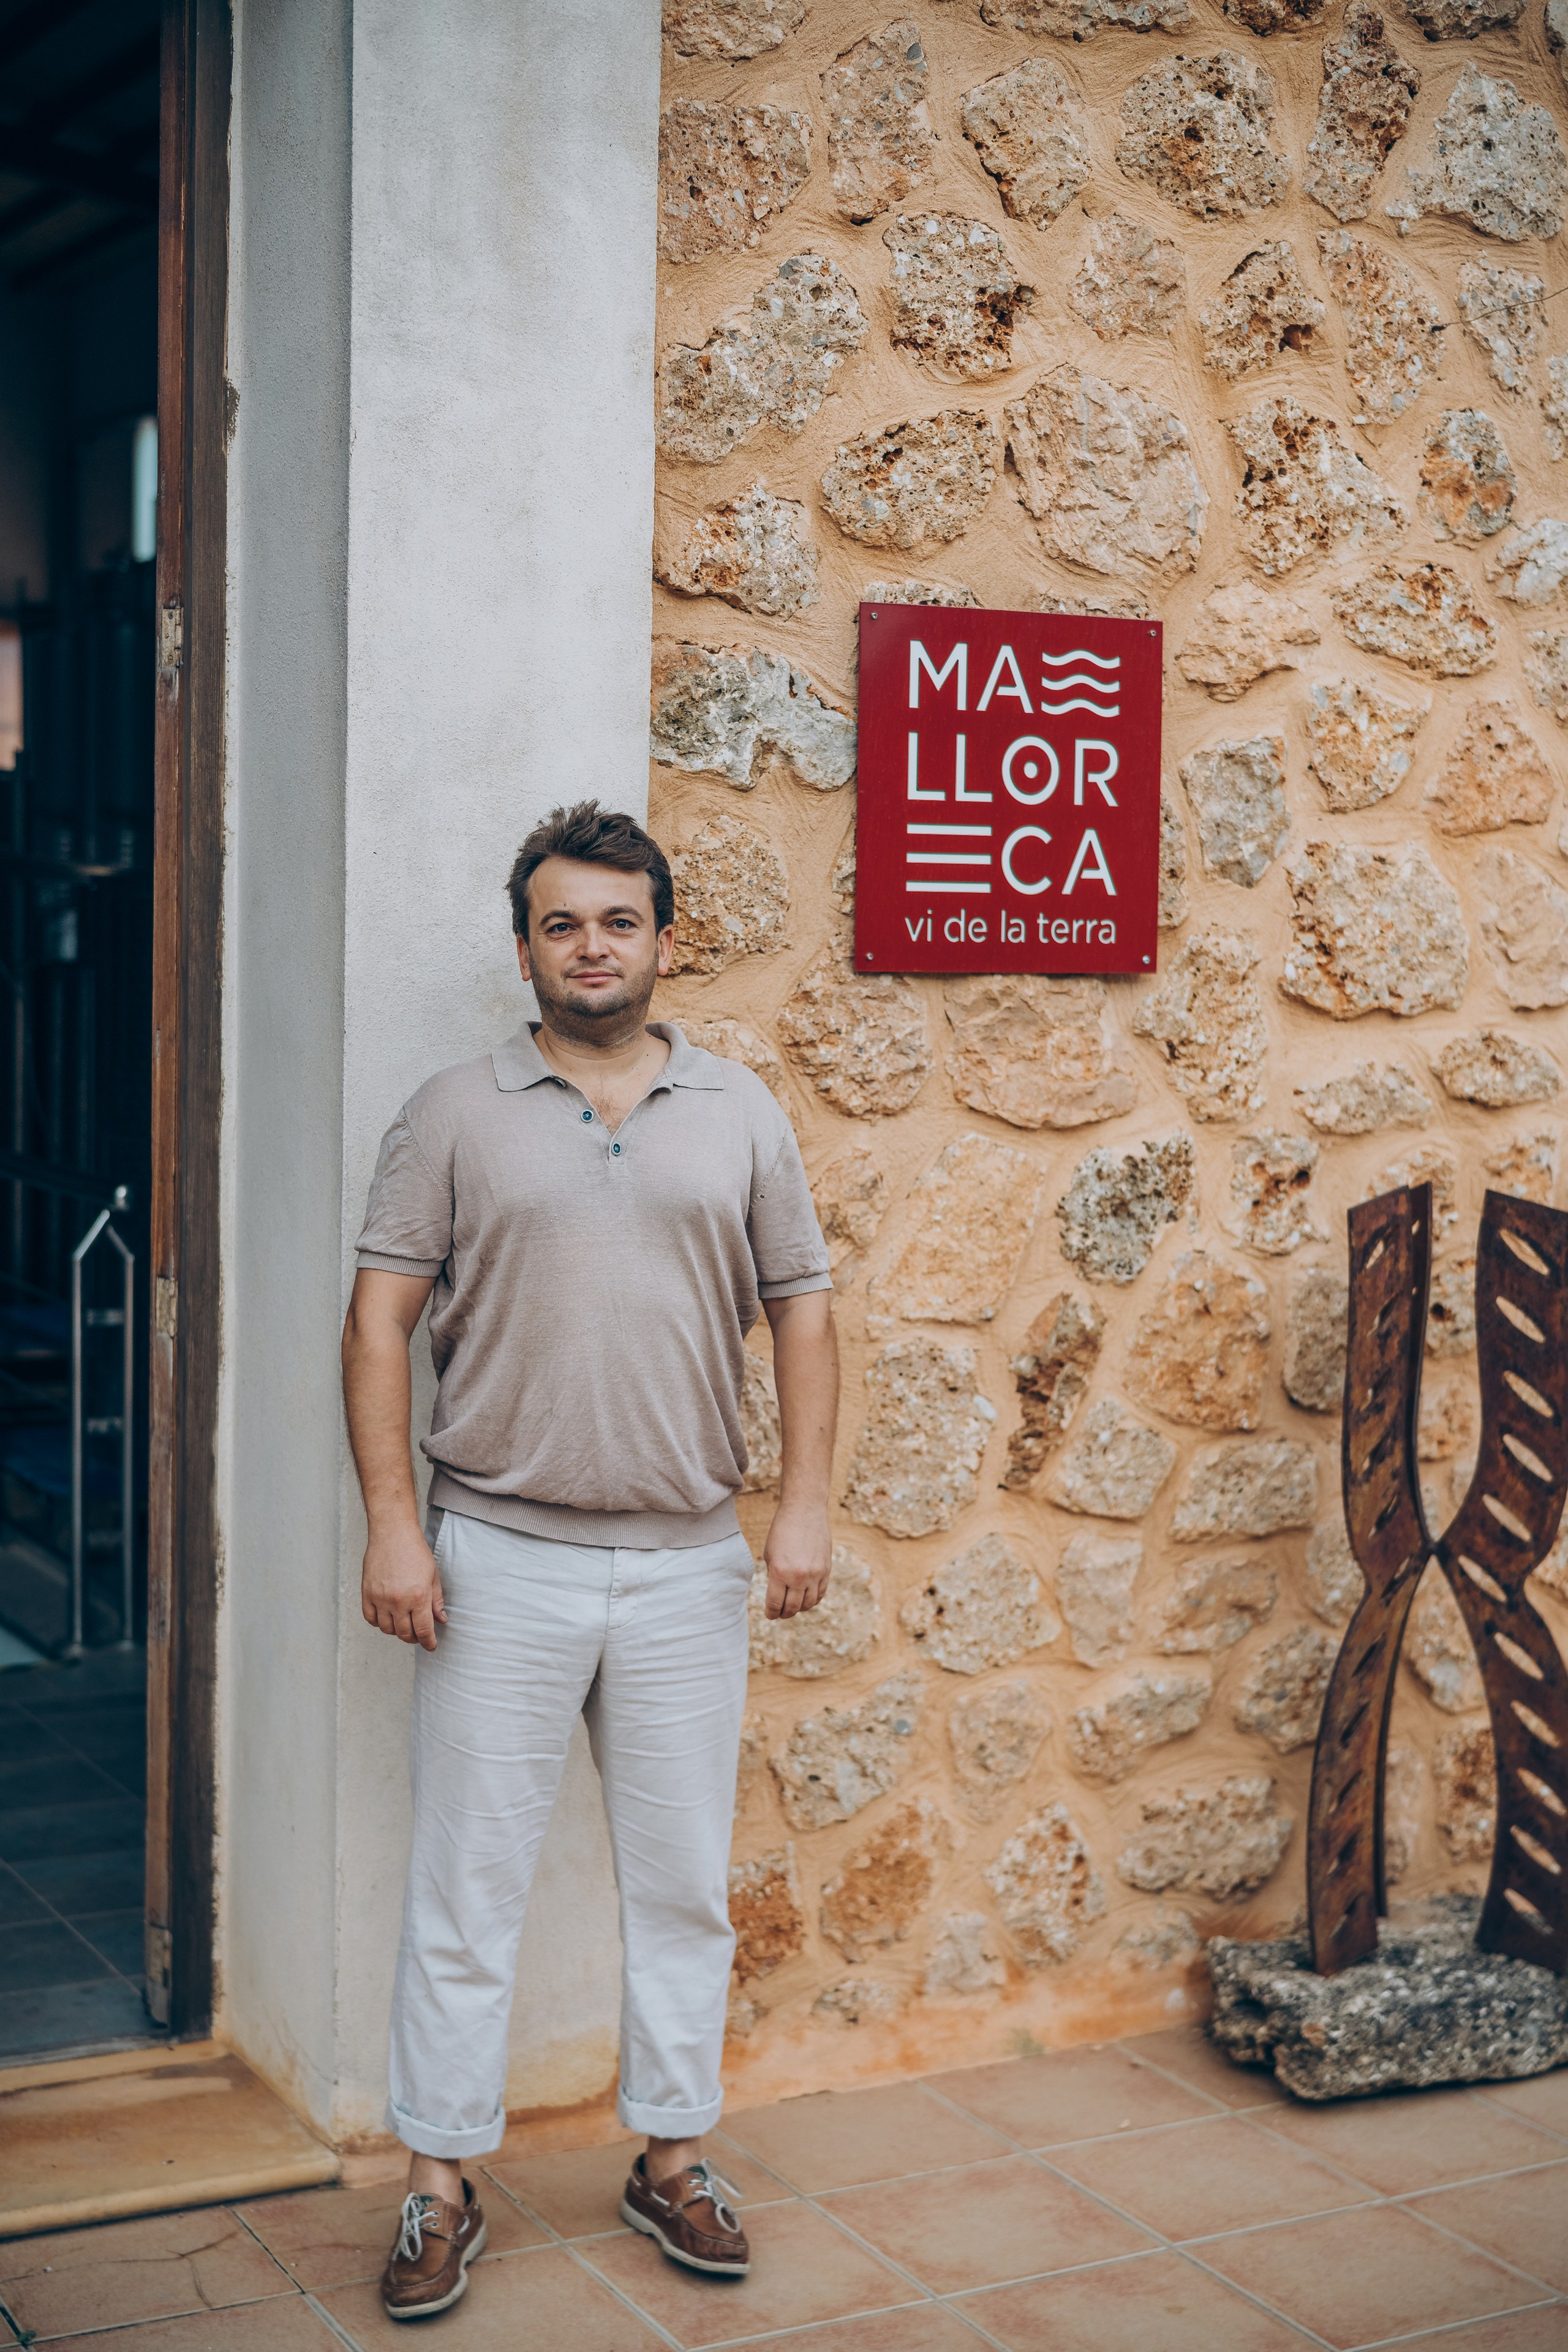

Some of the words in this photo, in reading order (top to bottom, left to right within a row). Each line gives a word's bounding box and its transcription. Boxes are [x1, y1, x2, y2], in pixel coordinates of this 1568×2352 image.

[909, 640, 1034, 714] MA
[907, 731, 1120, 807] LLOR
[905, 909, 933, 943] vi
[943, 908, 988, 943] de
[1000, 910, 1026, 944] la
[1036, 913, 1117, 944] terra
